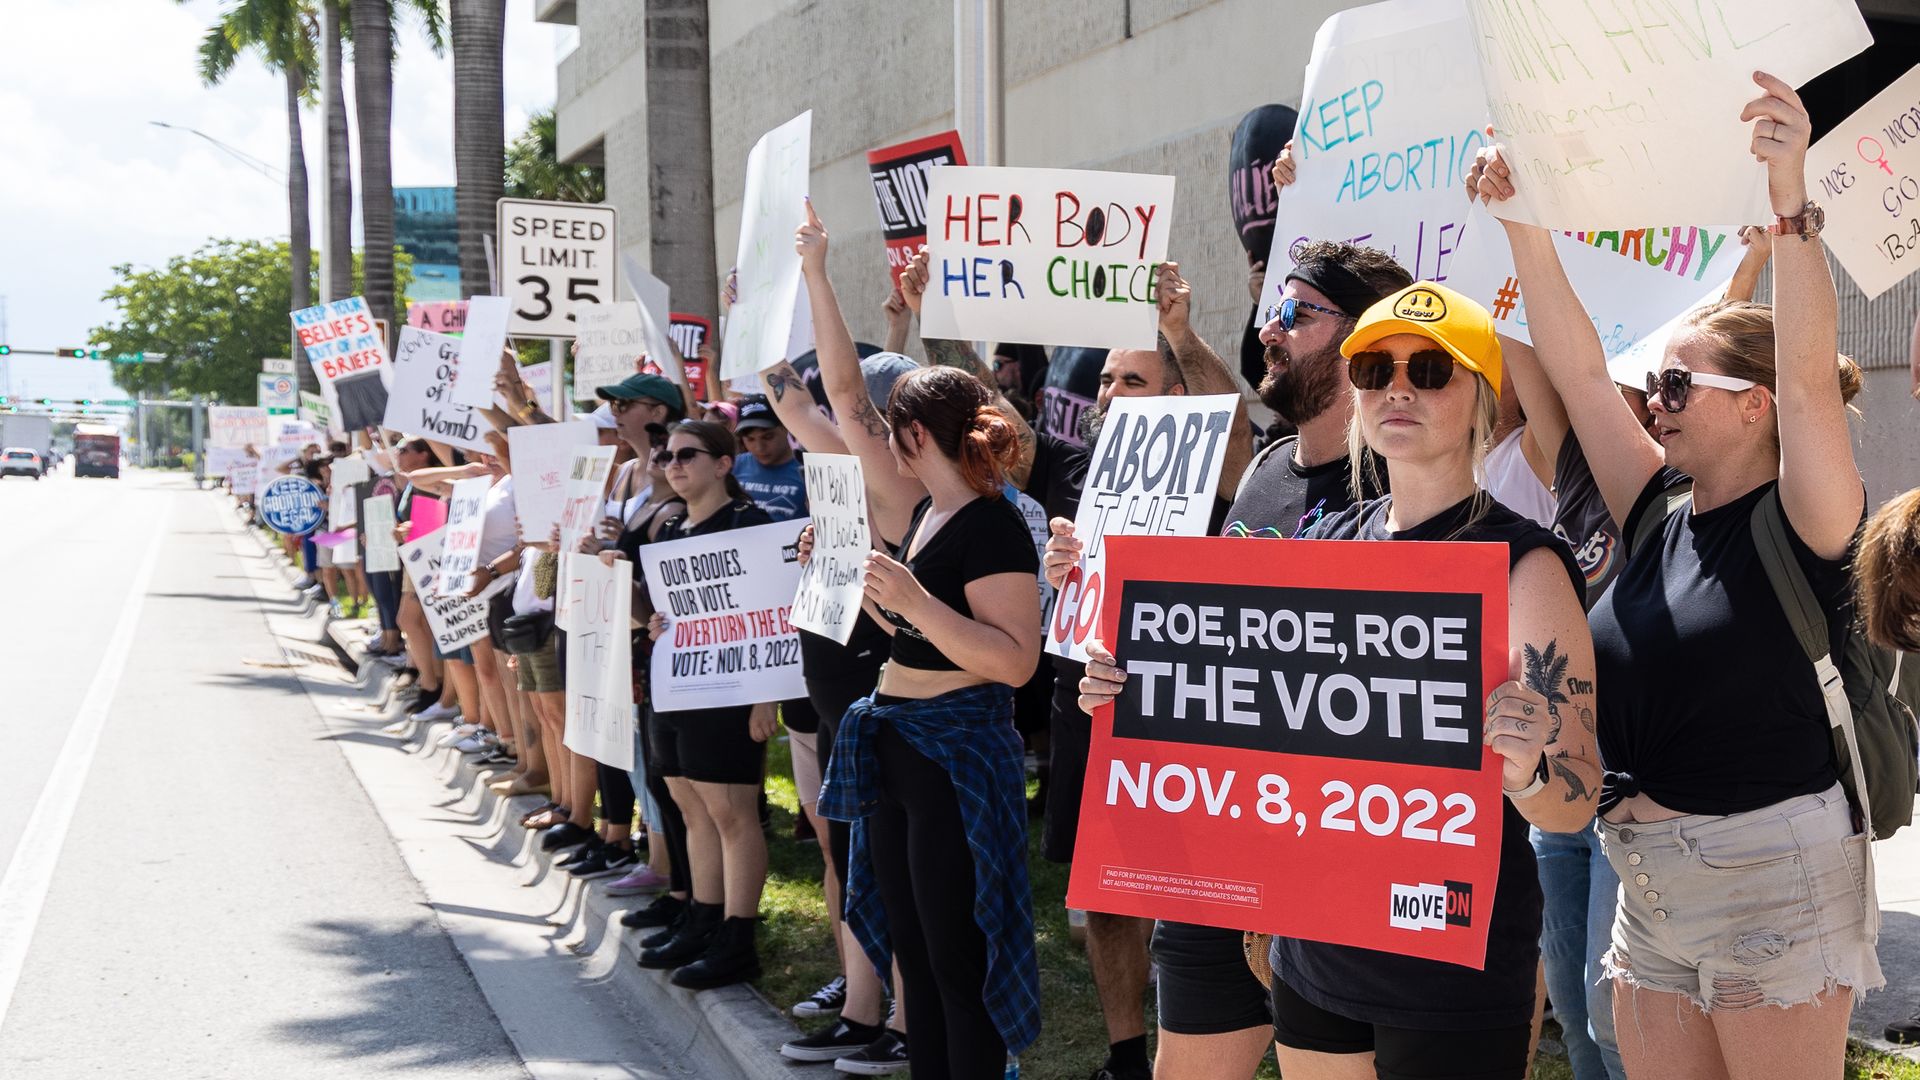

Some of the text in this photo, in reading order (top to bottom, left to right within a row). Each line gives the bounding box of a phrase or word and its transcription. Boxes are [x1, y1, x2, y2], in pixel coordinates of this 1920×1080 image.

[1300, 79, 1384, 160] KEEP
[889, 154, 951, 228] VOT
[1819, 162, 1855, 200] WE
[1883, 175, 1919, 218] GO
[512, 216, 606, 241] SPEED
[944, 190, 1156, 260] HER BODY
[521, 245, 595, 269] LIMIT
[943, 255, 1160, 305] HER CHOICE
[295, 298, 363, 325] KEEP YOUR
[515, 275, 600, 321] 35
[1401, 307, 1435, 318] drew
[297, 314, 370, 347] BELIEFS
[420, 309, 434, 329] A
[304, 342, 333, 362] OUT
[356, 334, 376, 350] MY
[321, 349, 382, 378] BRIEFS
[421, 407, 477, 441] Womb
[1091, 410, 1232, 494] ABORT
[263, 490, 320, 513] ABORTION
[271, 479, 310, 495] KEEP
[271, 507, 318, 527] LEGAL
[660, 548, 746, 587] OUR BODIES.
[782, 548, 798, 560] MO
[572, 578, 615, 625] FUC
[668, 582, 740, 617] OUR VOTE.
[1054, 565, 1103, 645] CO
[440, 619, 489, 645] SUPRE
[674, 613, 747, 648] OVERTURN
[747, 608, 777, 639] THE
[1357, 613, 1468, 661] ROE
[671, 638, 799, 677] VOTE: NOV. 8, 2022
[1126, 659, 1470, 744] THE VOTE
[1106, 759, 1476, 847] NOV. 8, 2022
[1106, 869, 1118, 878] PAID
[1118, 871, 1129, 879] FOR
[1169, 877, 1194, 887] POLITICAL
[1114, 880, 1145, 890] AUTHORIZED
[1163, 886, 1190, 896] CANDIDATE
